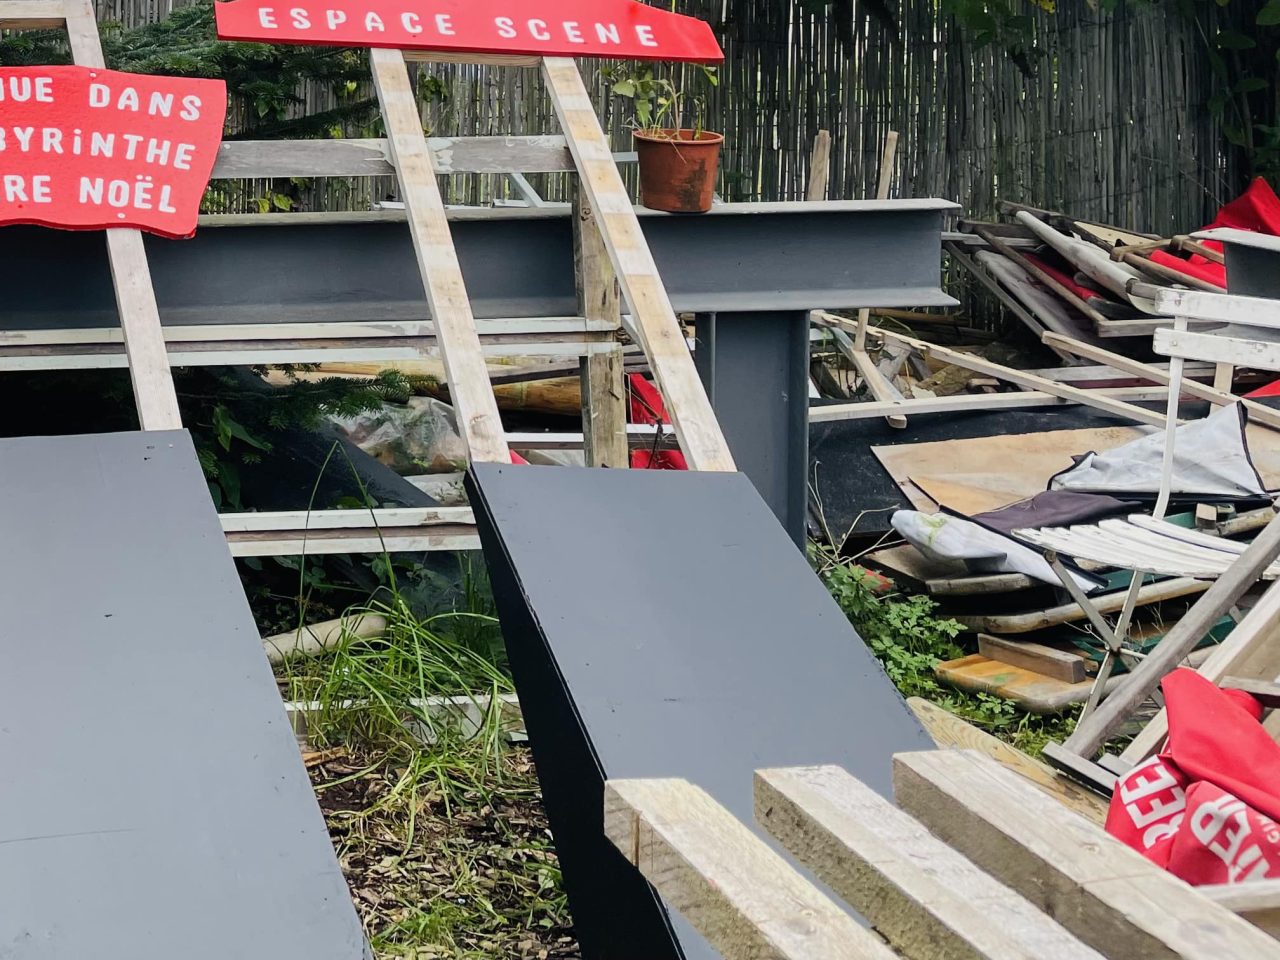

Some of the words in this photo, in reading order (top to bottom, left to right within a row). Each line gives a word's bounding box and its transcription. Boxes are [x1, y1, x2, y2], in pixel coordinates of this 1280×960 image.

[258, 7, 456, 36] ESPACE
[494, 16, 659, 47] SCENE
[89, 83, 202, 121] DANS
[79, 174, 177, 214] NOËL
